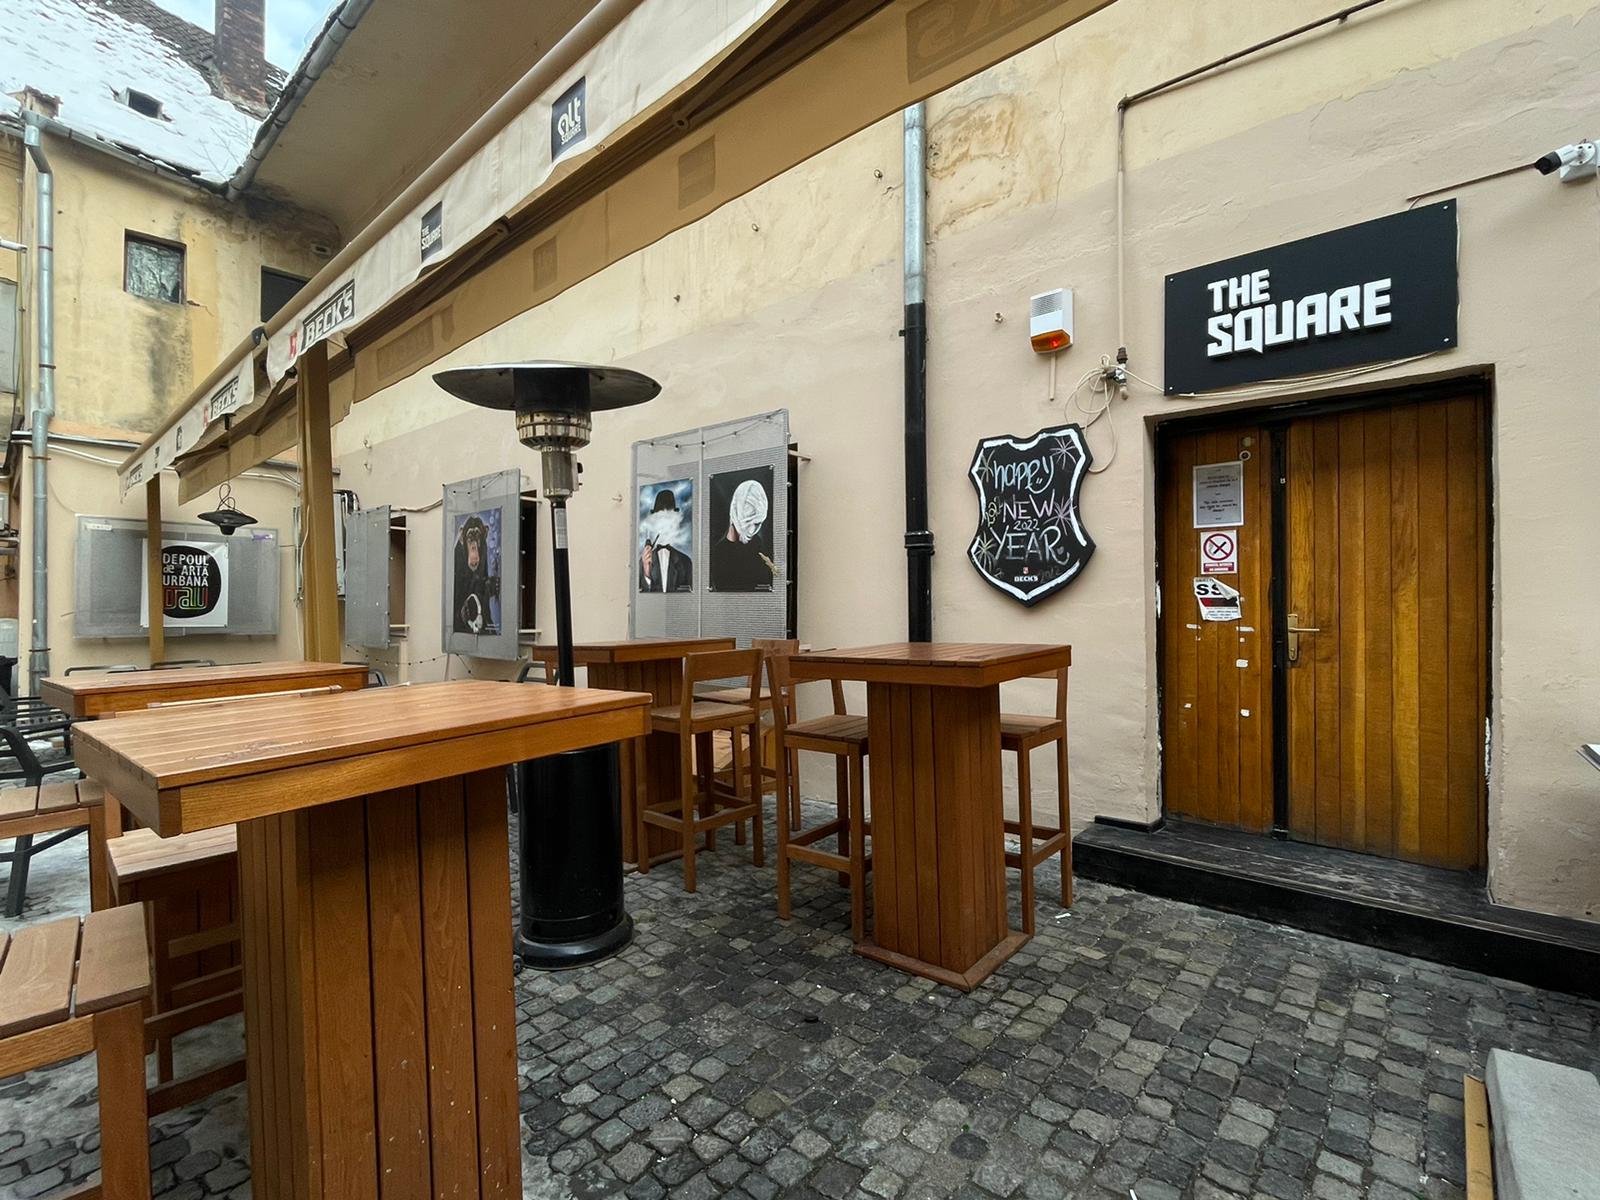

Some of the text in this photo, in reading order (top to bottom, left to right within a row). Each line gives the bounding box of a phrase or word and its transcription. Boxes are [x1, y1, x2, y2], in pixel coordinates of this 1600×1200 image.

[1207, 268, 1270, 313] THE
[1207, 278, 1391, 357] SQUARE
[1002, 489, 1055, 523] NEW
[1012, 519, 1041, 531] 2022
[162, 553, 209, 566] DEPOUL
[989, 525, 1070, 565] YEAR
